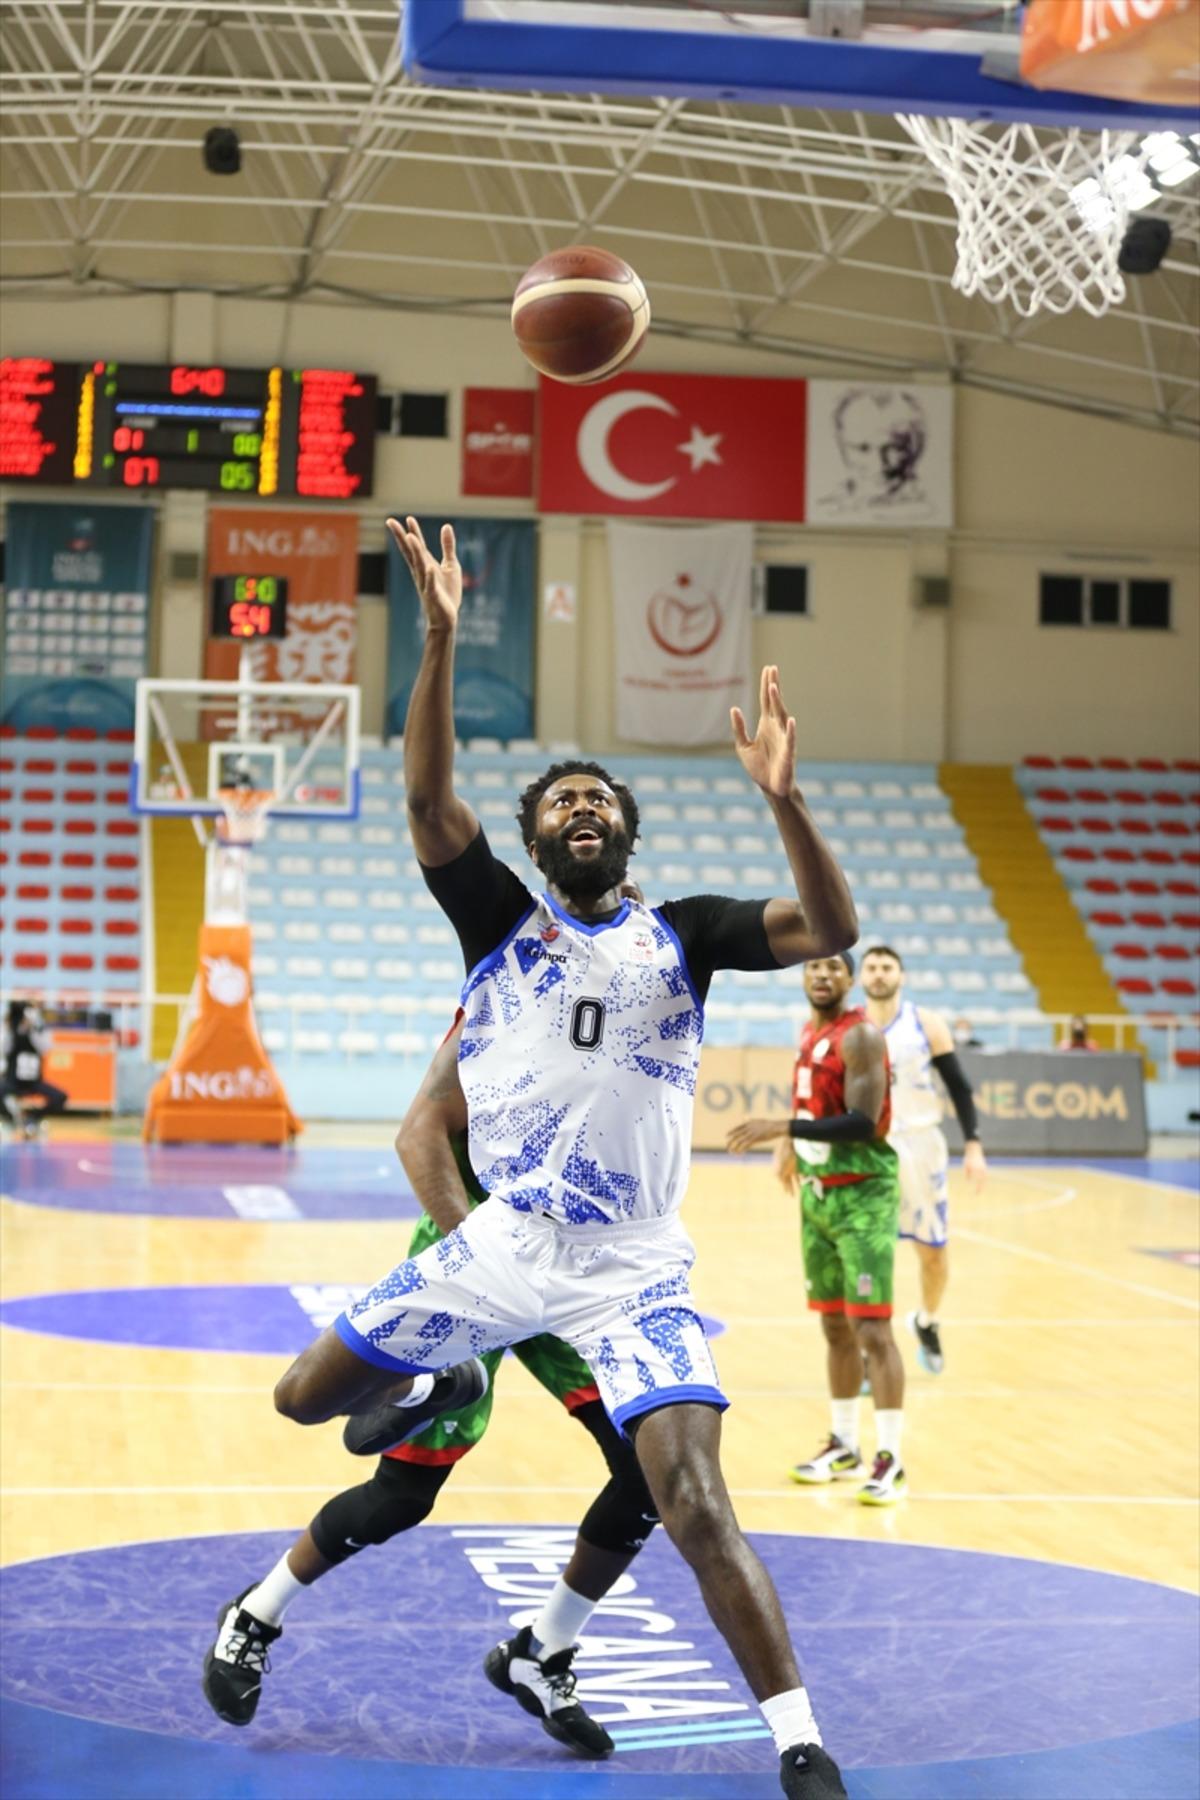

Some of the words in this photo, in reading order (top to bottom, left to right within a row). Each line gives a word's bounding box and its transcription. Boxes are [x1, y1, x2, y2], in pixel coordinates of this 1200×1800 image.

[228, 528, 292, 557] ING
[524, 945, 567, 964] Kempa
[569, 996, 606, 1052] 0
[171, 1070, 234, 1100] ING
